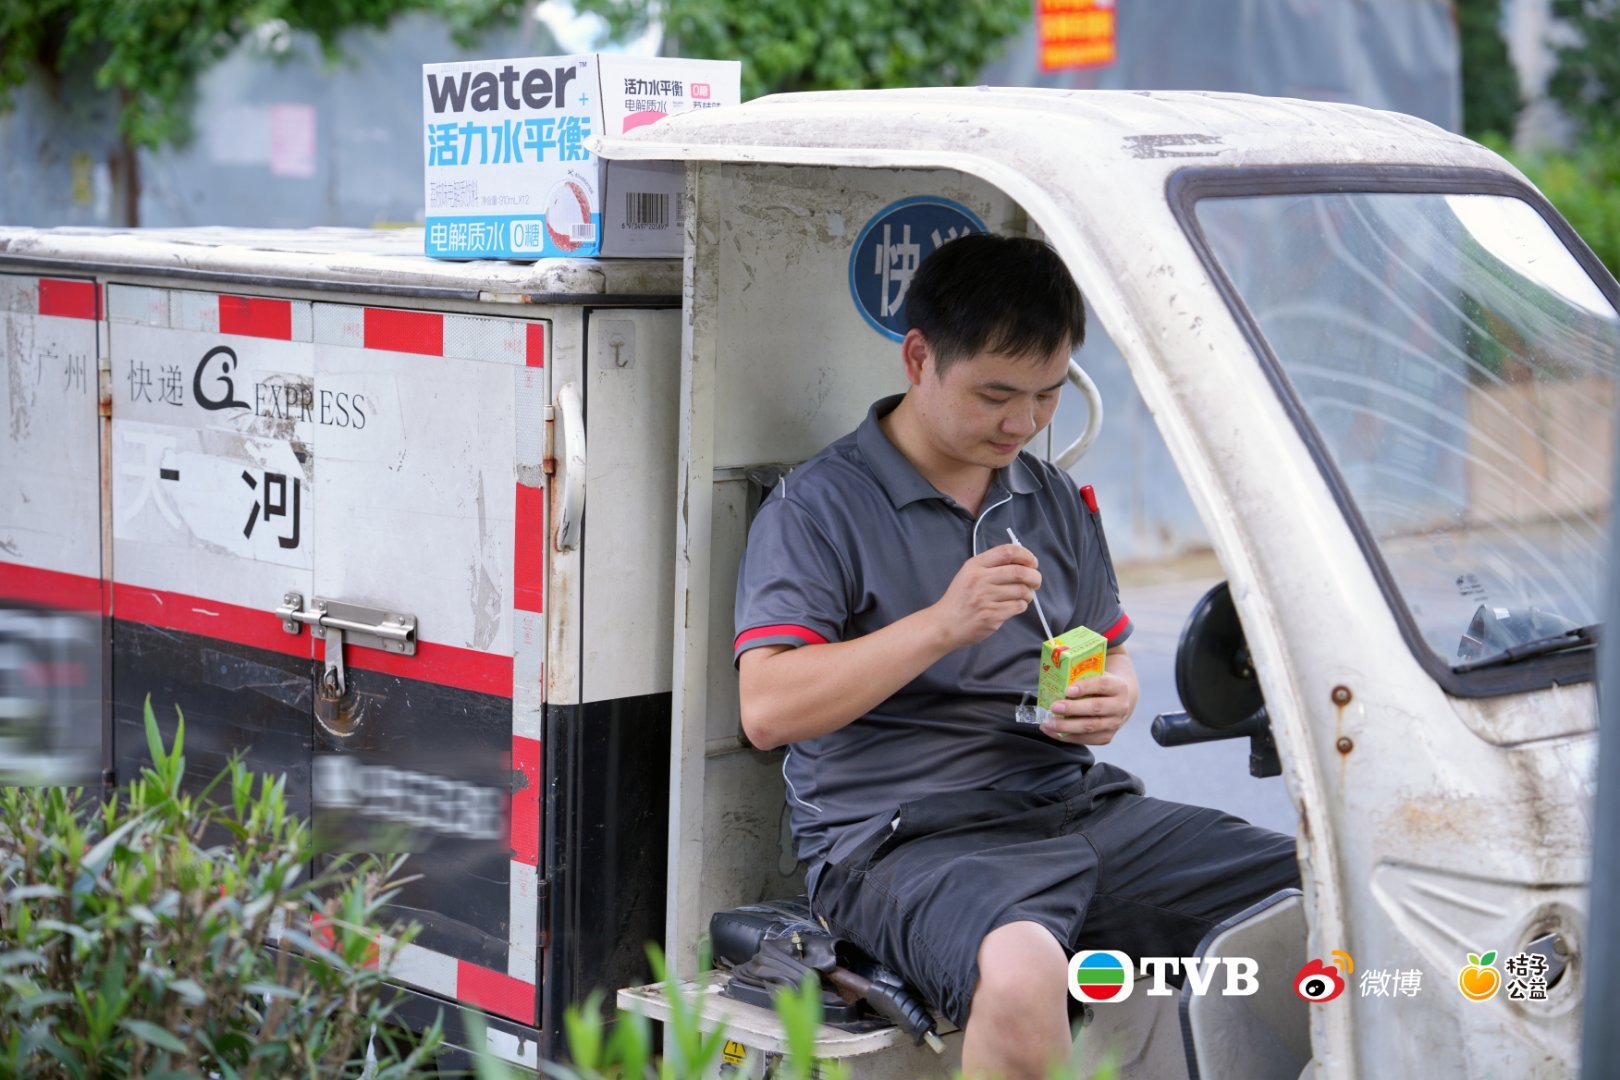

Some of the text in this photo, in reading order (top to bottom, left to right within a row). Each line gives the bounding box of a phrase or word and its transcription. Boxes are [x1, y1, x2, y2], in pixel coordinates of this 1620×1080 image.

[427, 65, 577, 113] water
[624, 78, 683, 96] 活力水平衡
[625, 99, 667, 112] 电解质水
[427, 116, 592, 167] 活力水平衡
[430, 221, 505, 252] 电解质水
[514, 223, 540, 248] 0糖
[37, 341, 87, 395] 广州
[127, 358, 184, 407] 快递
[254, 382, 367, 430] EXPRESS
